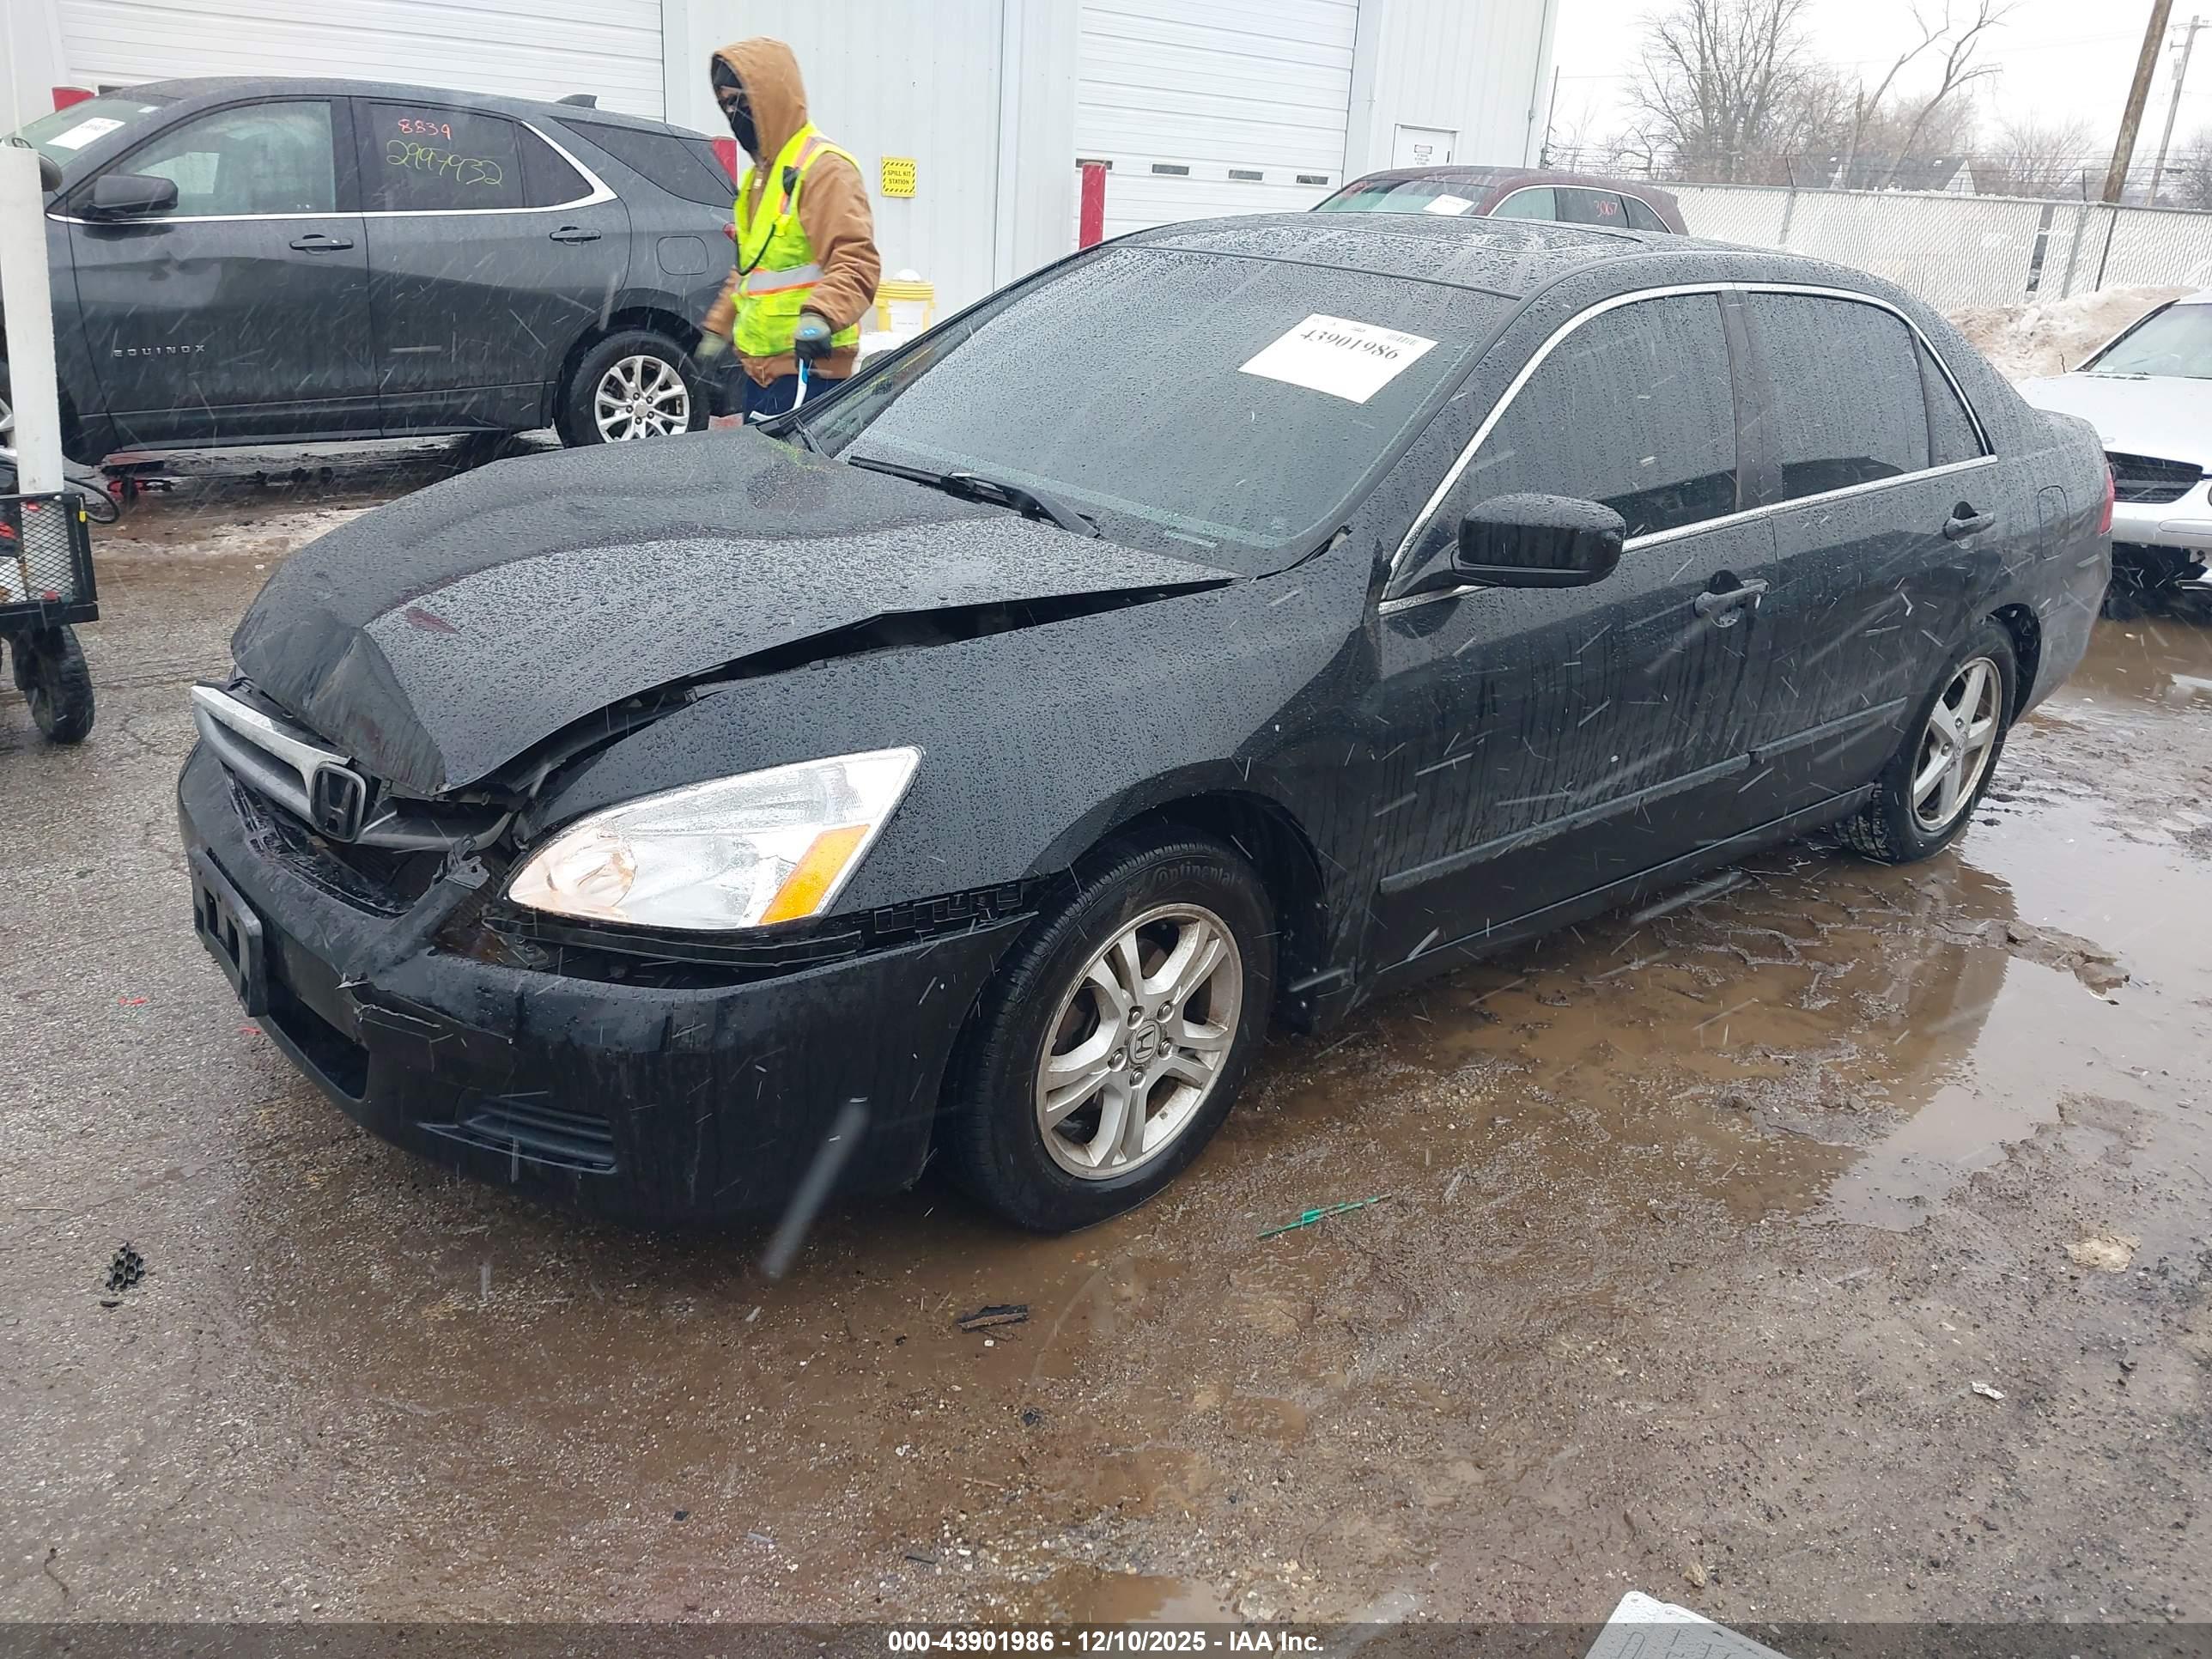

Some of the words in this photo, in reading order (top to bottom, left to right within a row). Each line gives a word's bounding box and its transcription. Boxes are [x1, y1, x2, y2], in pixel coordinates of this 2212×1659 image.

[398, 118, 451, 141] 8839
[386, 139, 502, 186] 2997932
[112, 344, 205, 357] EQUINOX
[1300, 329, 1402, 361] 43901986
[1152, 861, 1236, 888] Continental
